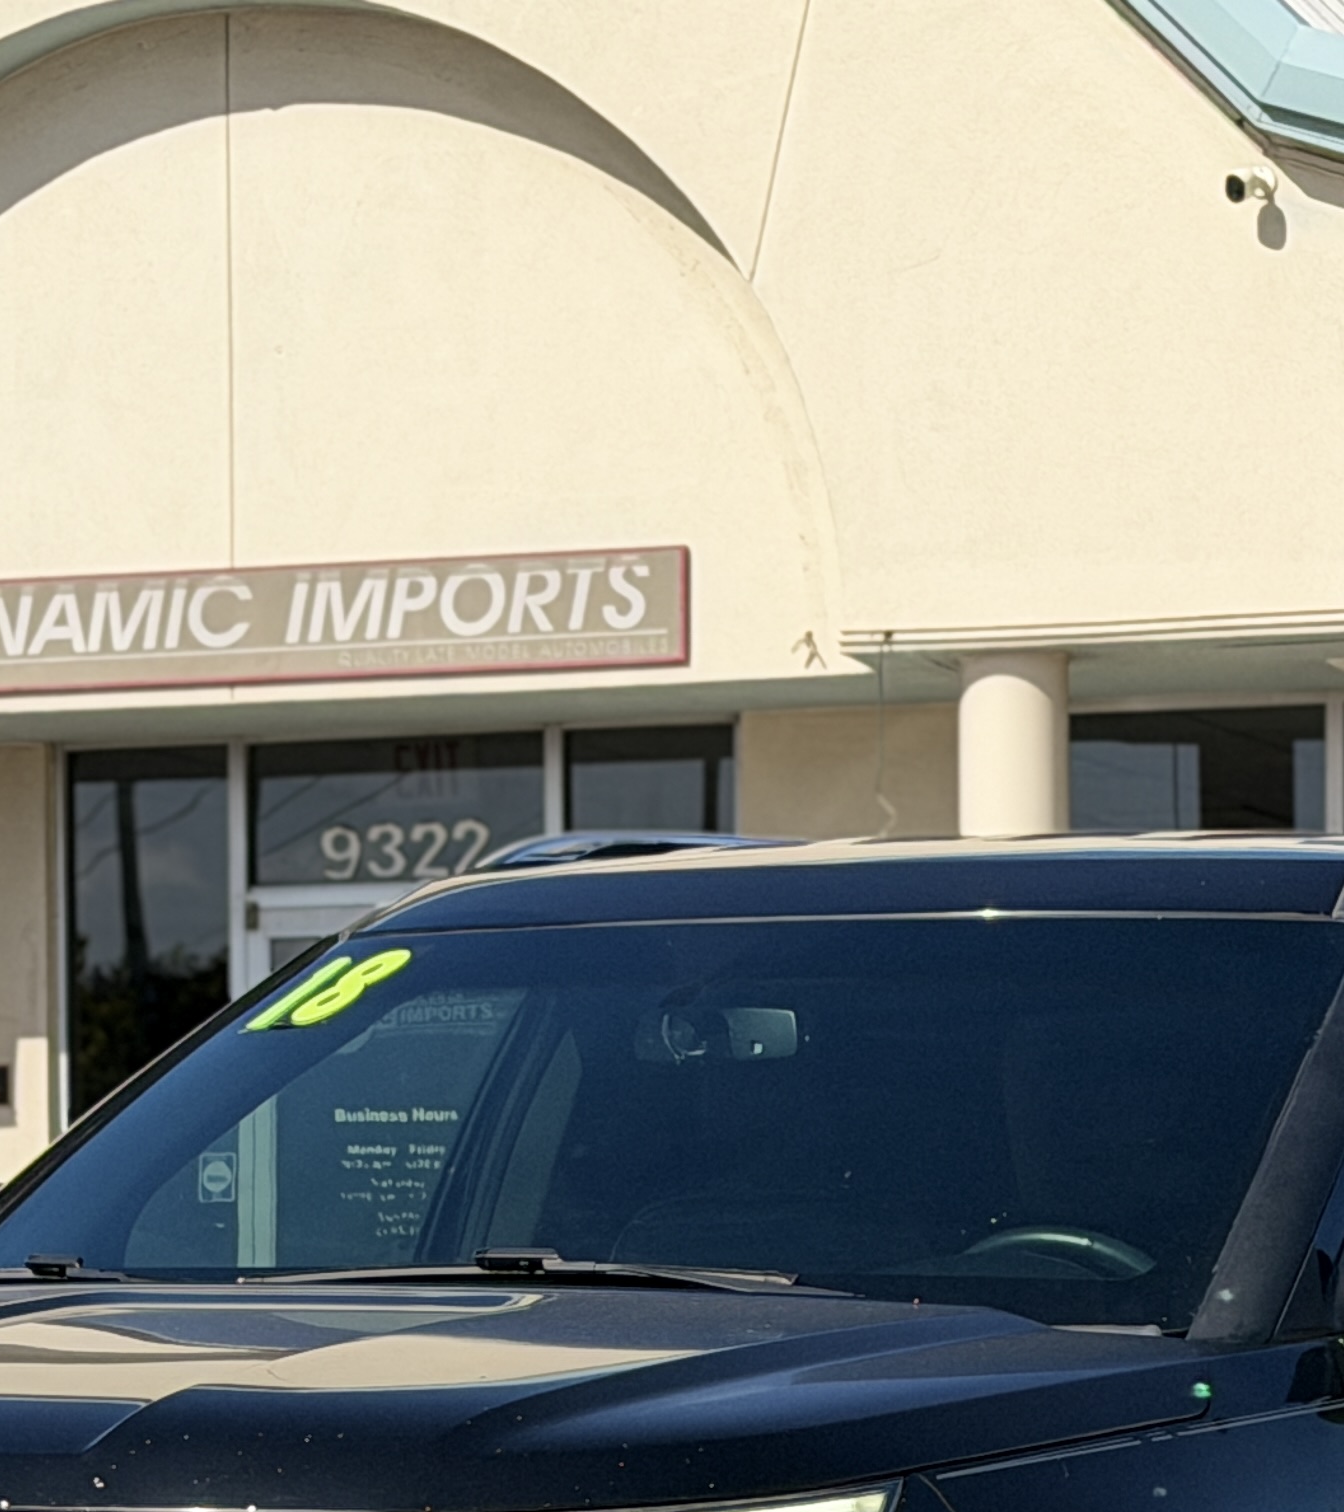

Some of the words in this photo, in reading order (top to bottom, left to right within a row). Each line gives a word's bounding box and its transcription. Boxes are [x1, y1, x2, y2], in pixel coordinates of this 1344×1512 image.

[284, 556, 651, 645] IMPORTS
[320, 817, 491, 881] 9322
[399, 1001, 495, 1025] IMPORTS
[335, 1107, 408, 1123] Business
[411, 1107, 458, 1122] Hours
[347, 1144, 397, 1158] Monday
